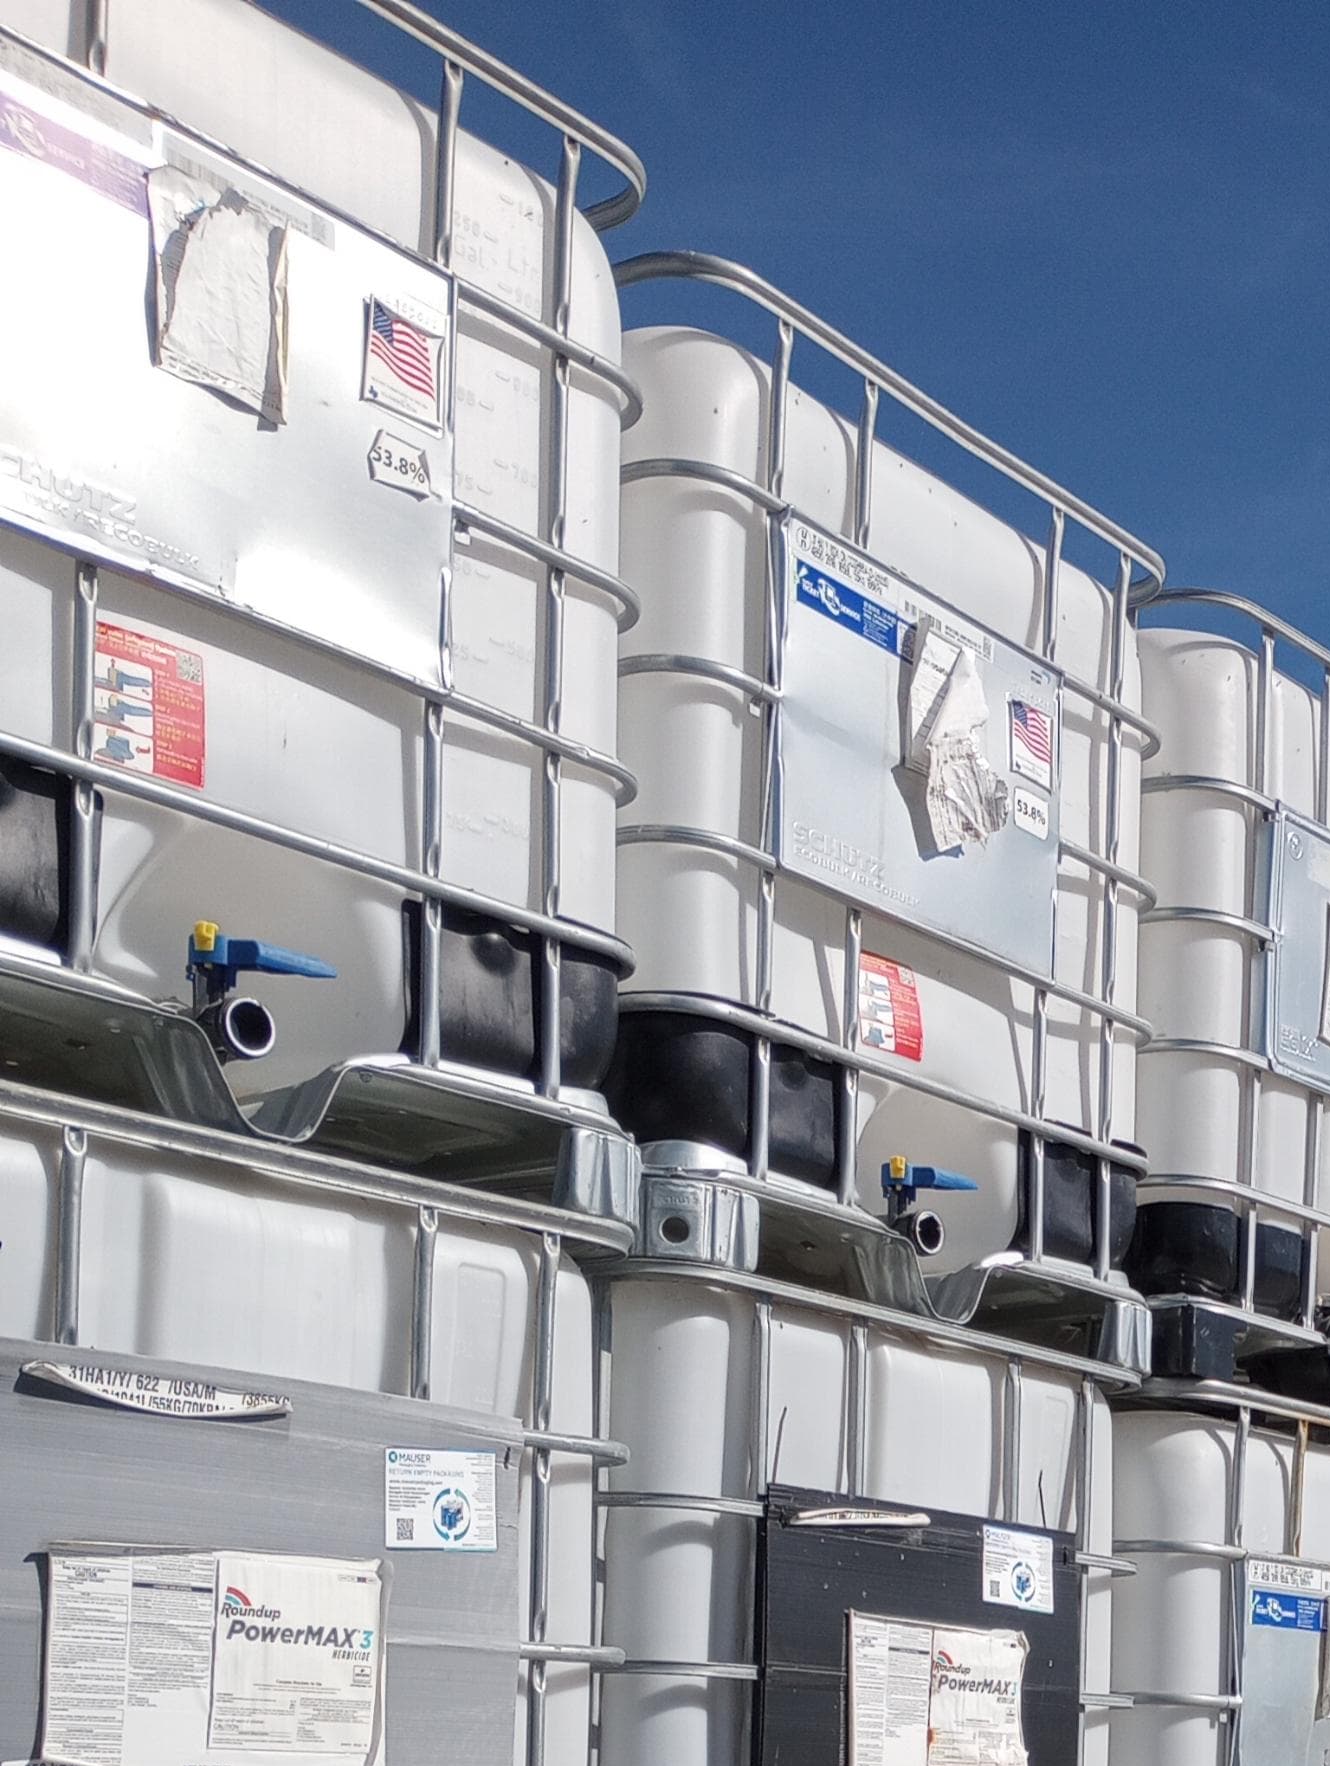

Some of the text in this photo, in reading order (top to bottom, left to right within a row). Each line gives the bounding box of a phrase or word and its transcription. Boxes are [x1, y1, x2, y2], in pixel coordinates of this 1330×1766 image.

[372, 445, 427, 485] 53.8%
[1015, 799, 1047, 827] 53.8%
[135, 1373, 161, 1394] 622
[399, 1453, 432, 1464] MAUSER
[220, 1601, 281, 1622] Roundup
[225, 1619, 375, 1650] PowerMAX 3
[332, 1649, 371, 1663] HERBICIDE
[935, 1661, 971, 1676] Roundup
[938, 1674, 1012, 1697] PowerMAX
